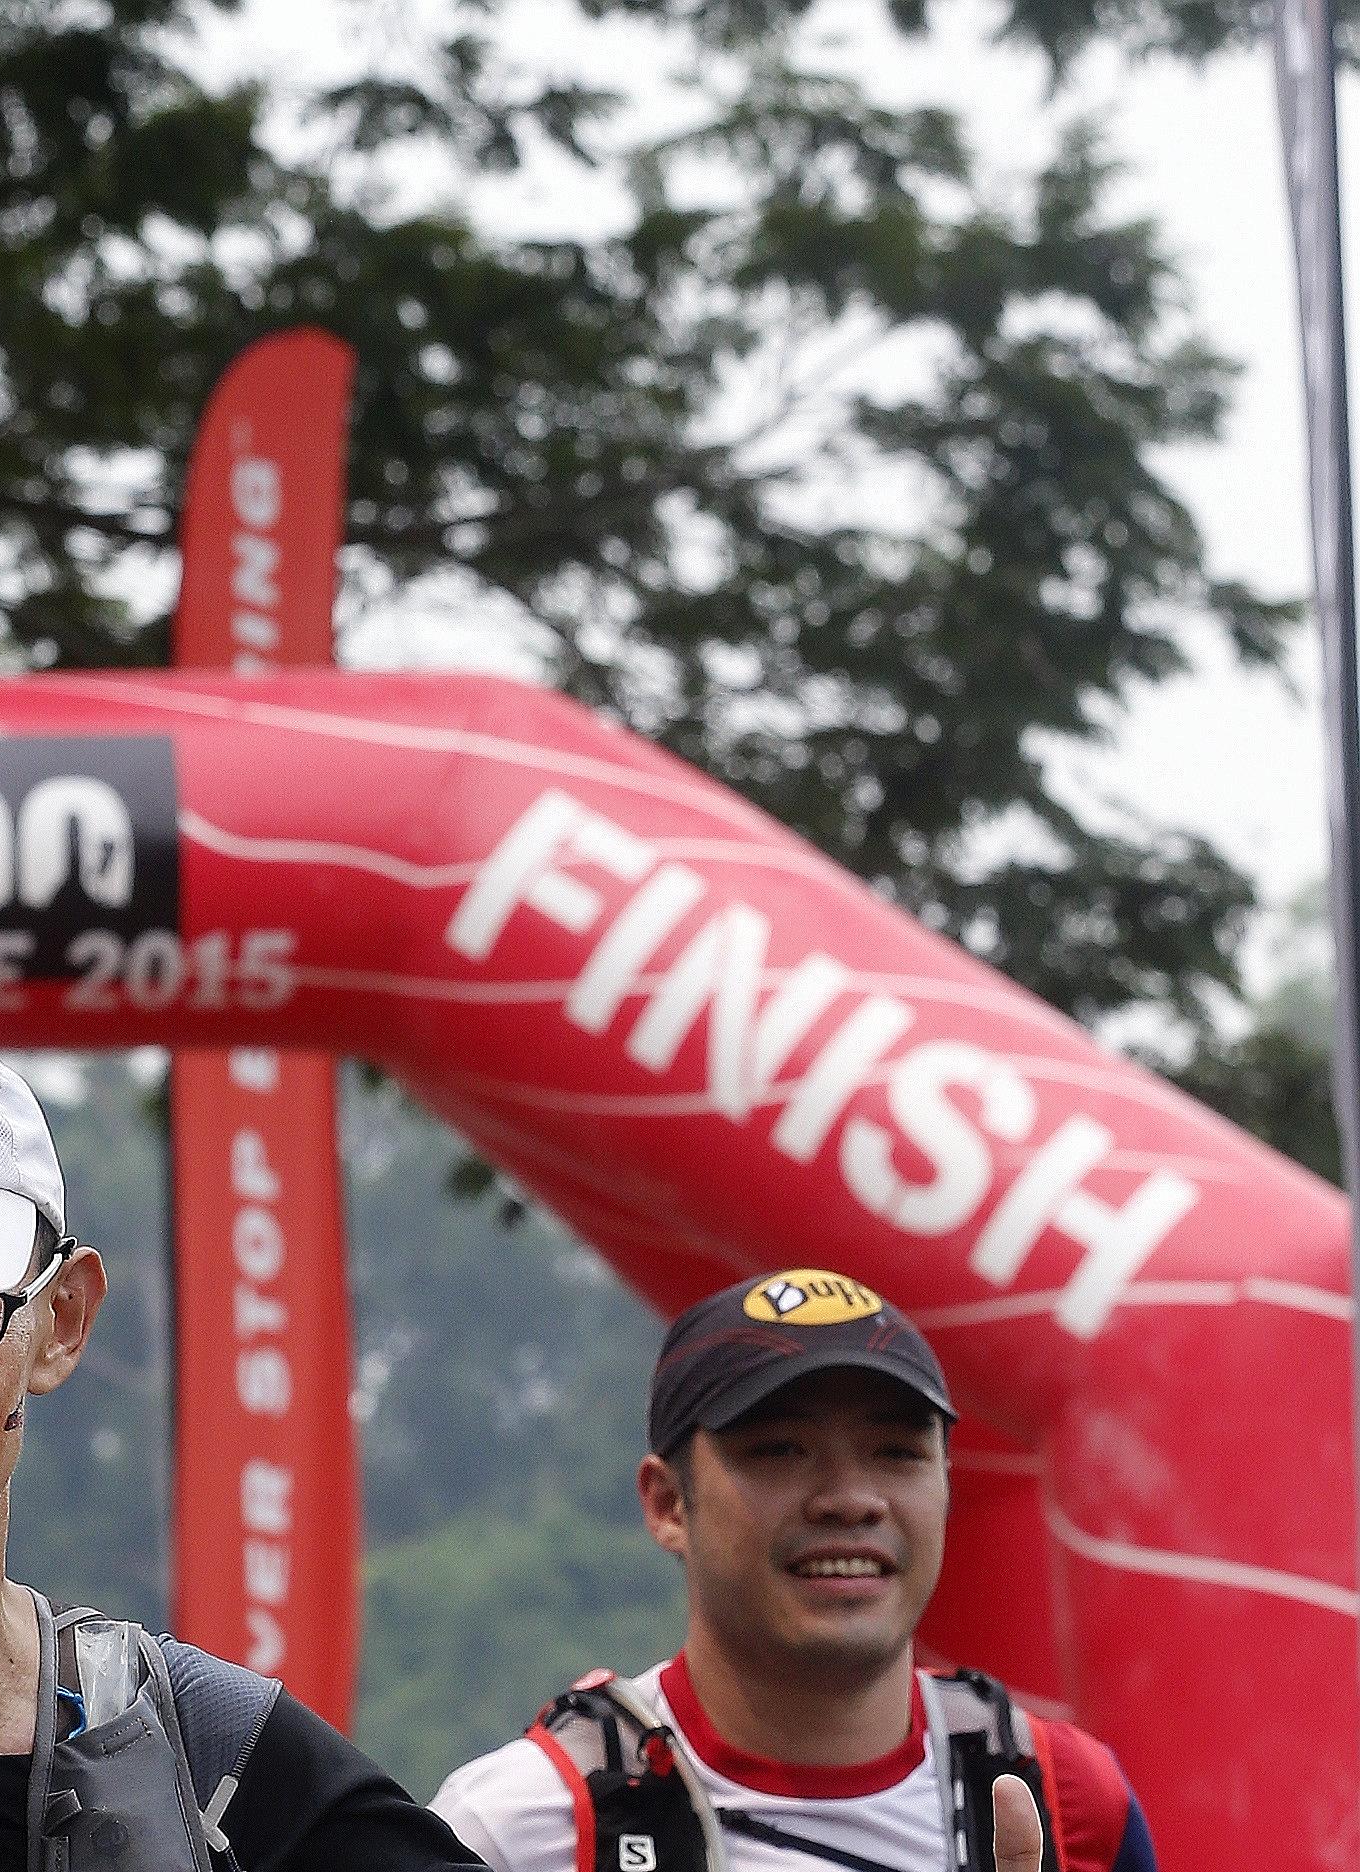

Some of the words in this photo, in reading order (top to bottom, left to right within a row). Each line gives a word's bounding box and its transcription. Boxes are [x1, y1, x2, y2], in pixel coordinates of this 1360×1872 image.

[62, 927, 298, 1016] 2015
[446, 789, 1200, 1341] FINISH
[230, 1129, 293, 1417] STOP
